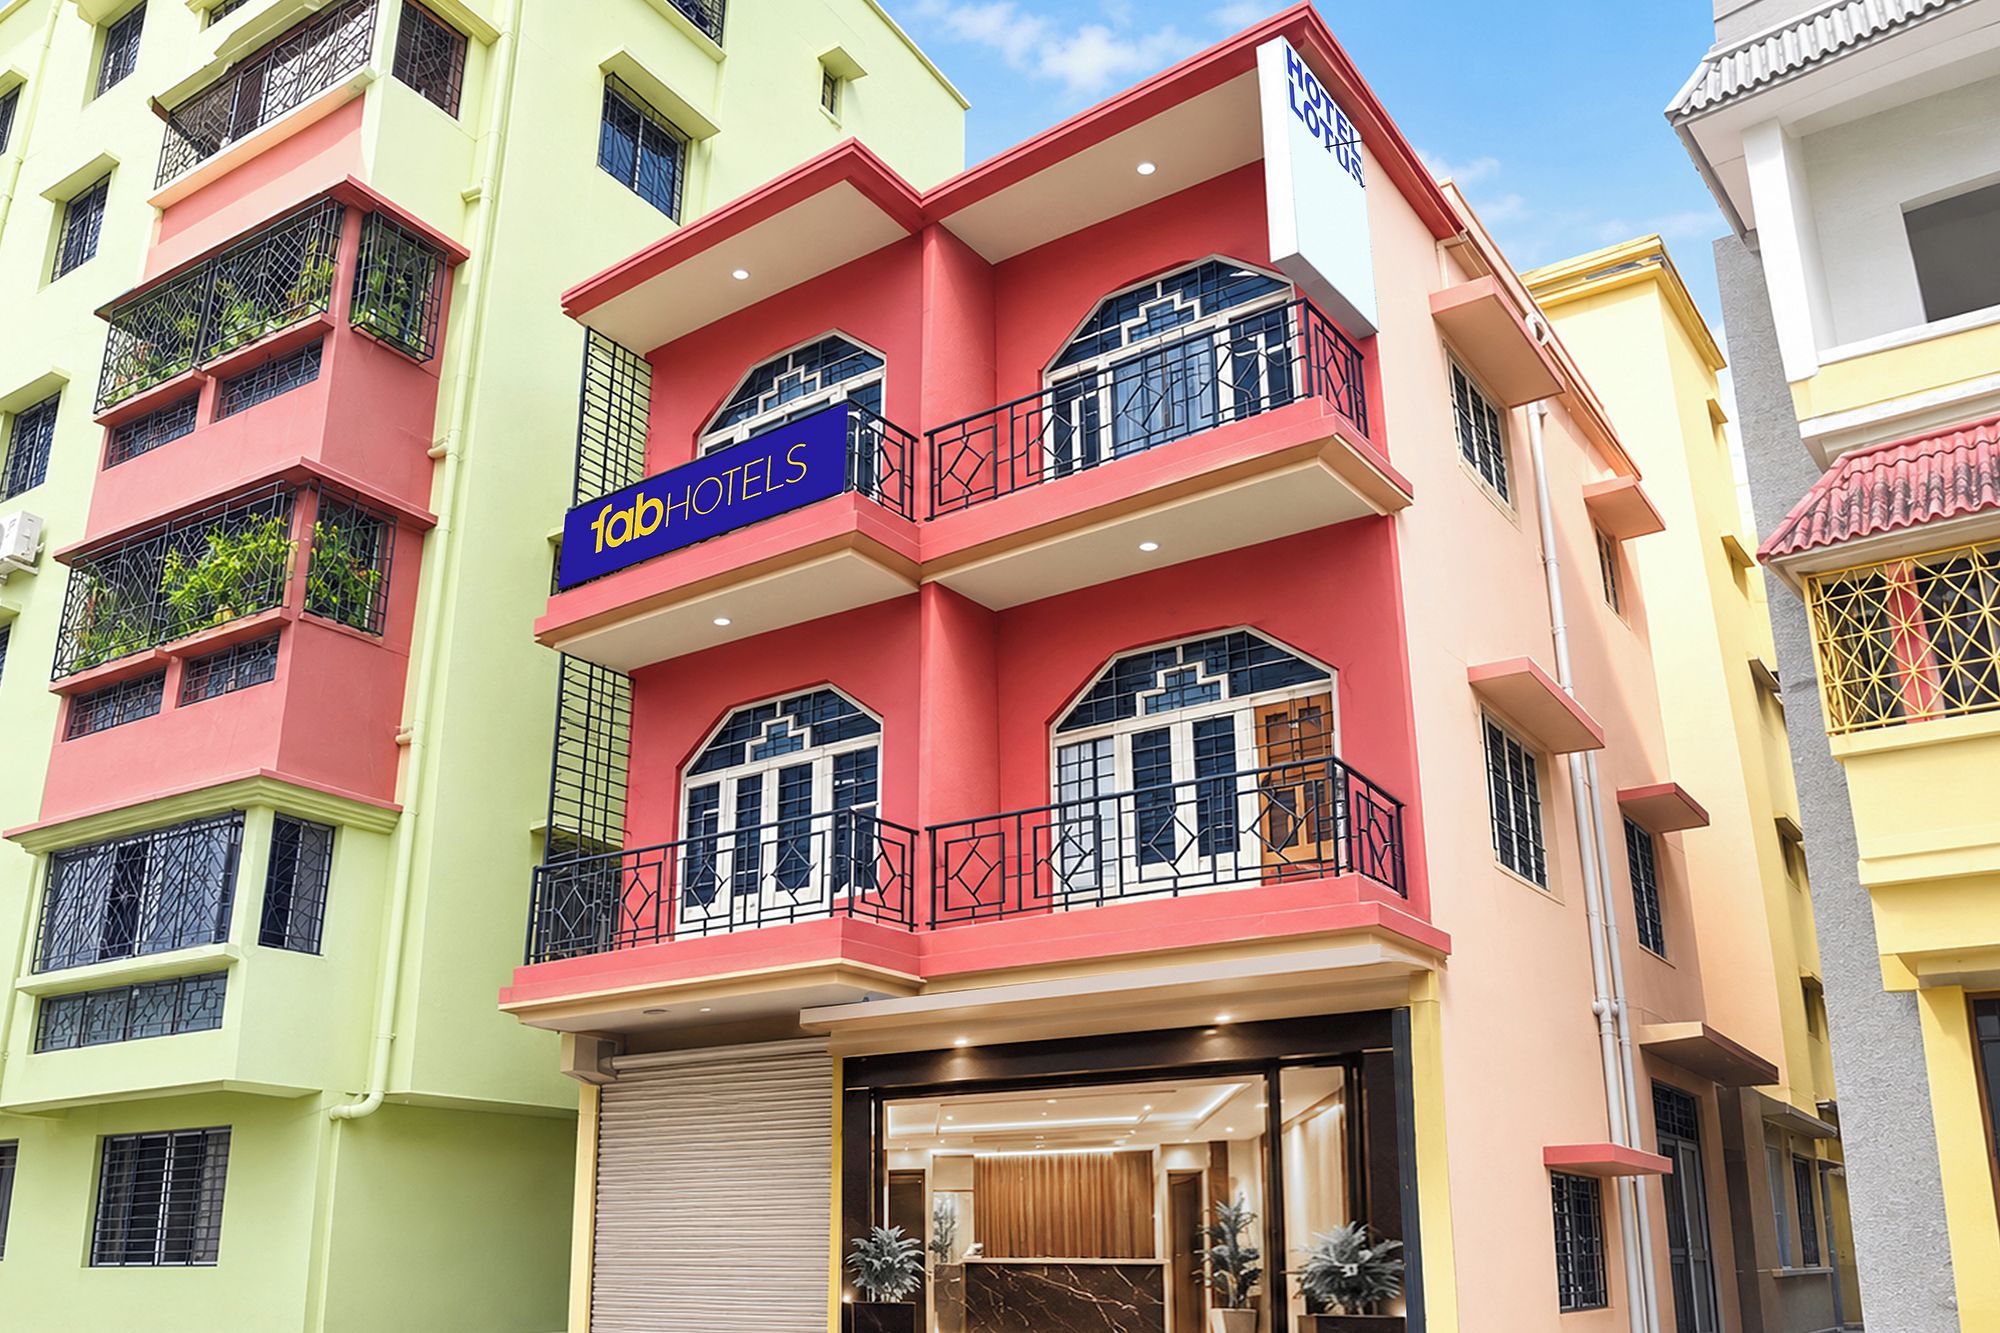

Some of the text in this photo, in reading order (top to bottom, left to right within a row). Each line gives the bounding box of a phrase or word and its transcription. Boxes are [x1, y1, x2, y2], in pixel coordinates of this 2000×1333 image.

[1286, 44, 1362, 164] HOTEL
[1288, 78, 1366, 189] LOTUS
[591, 443, 807, 554] fabHOTELS
